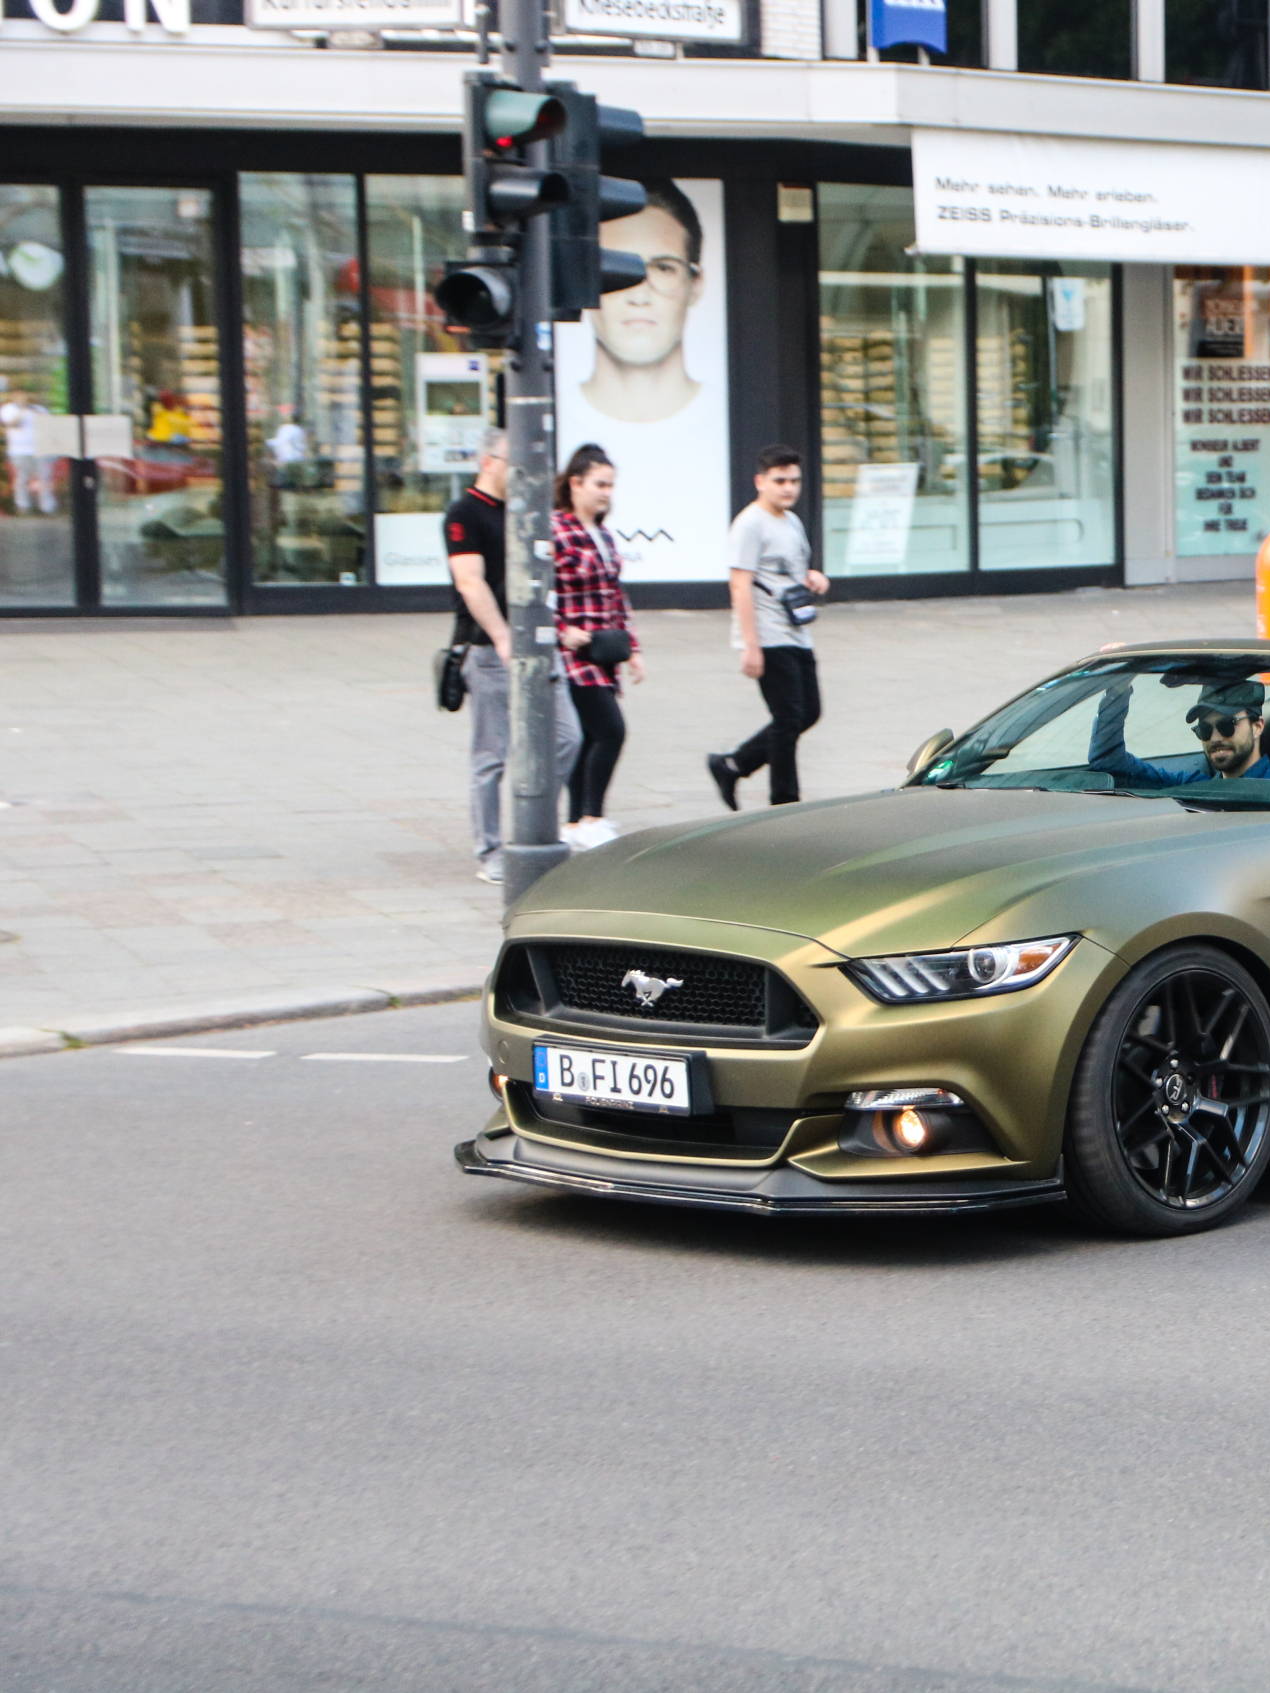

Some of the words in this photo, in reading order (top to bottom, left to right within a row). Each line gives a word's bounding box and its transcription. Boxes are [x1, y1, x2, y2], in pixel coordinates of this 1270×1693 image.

[936, 177, 980, 193] Mehr
[988, 184, 1041, 198] sehen.
[1048, 185, 1088, 201] Mehr
[1095, 190, 1159, 204] erleben.
[937, 206, 992, 223] ZEISS
[559, 1054, 575, 1087] B
[591, 1058, 622, 1094] FI
[628, 1062, 675, 1099] 696
